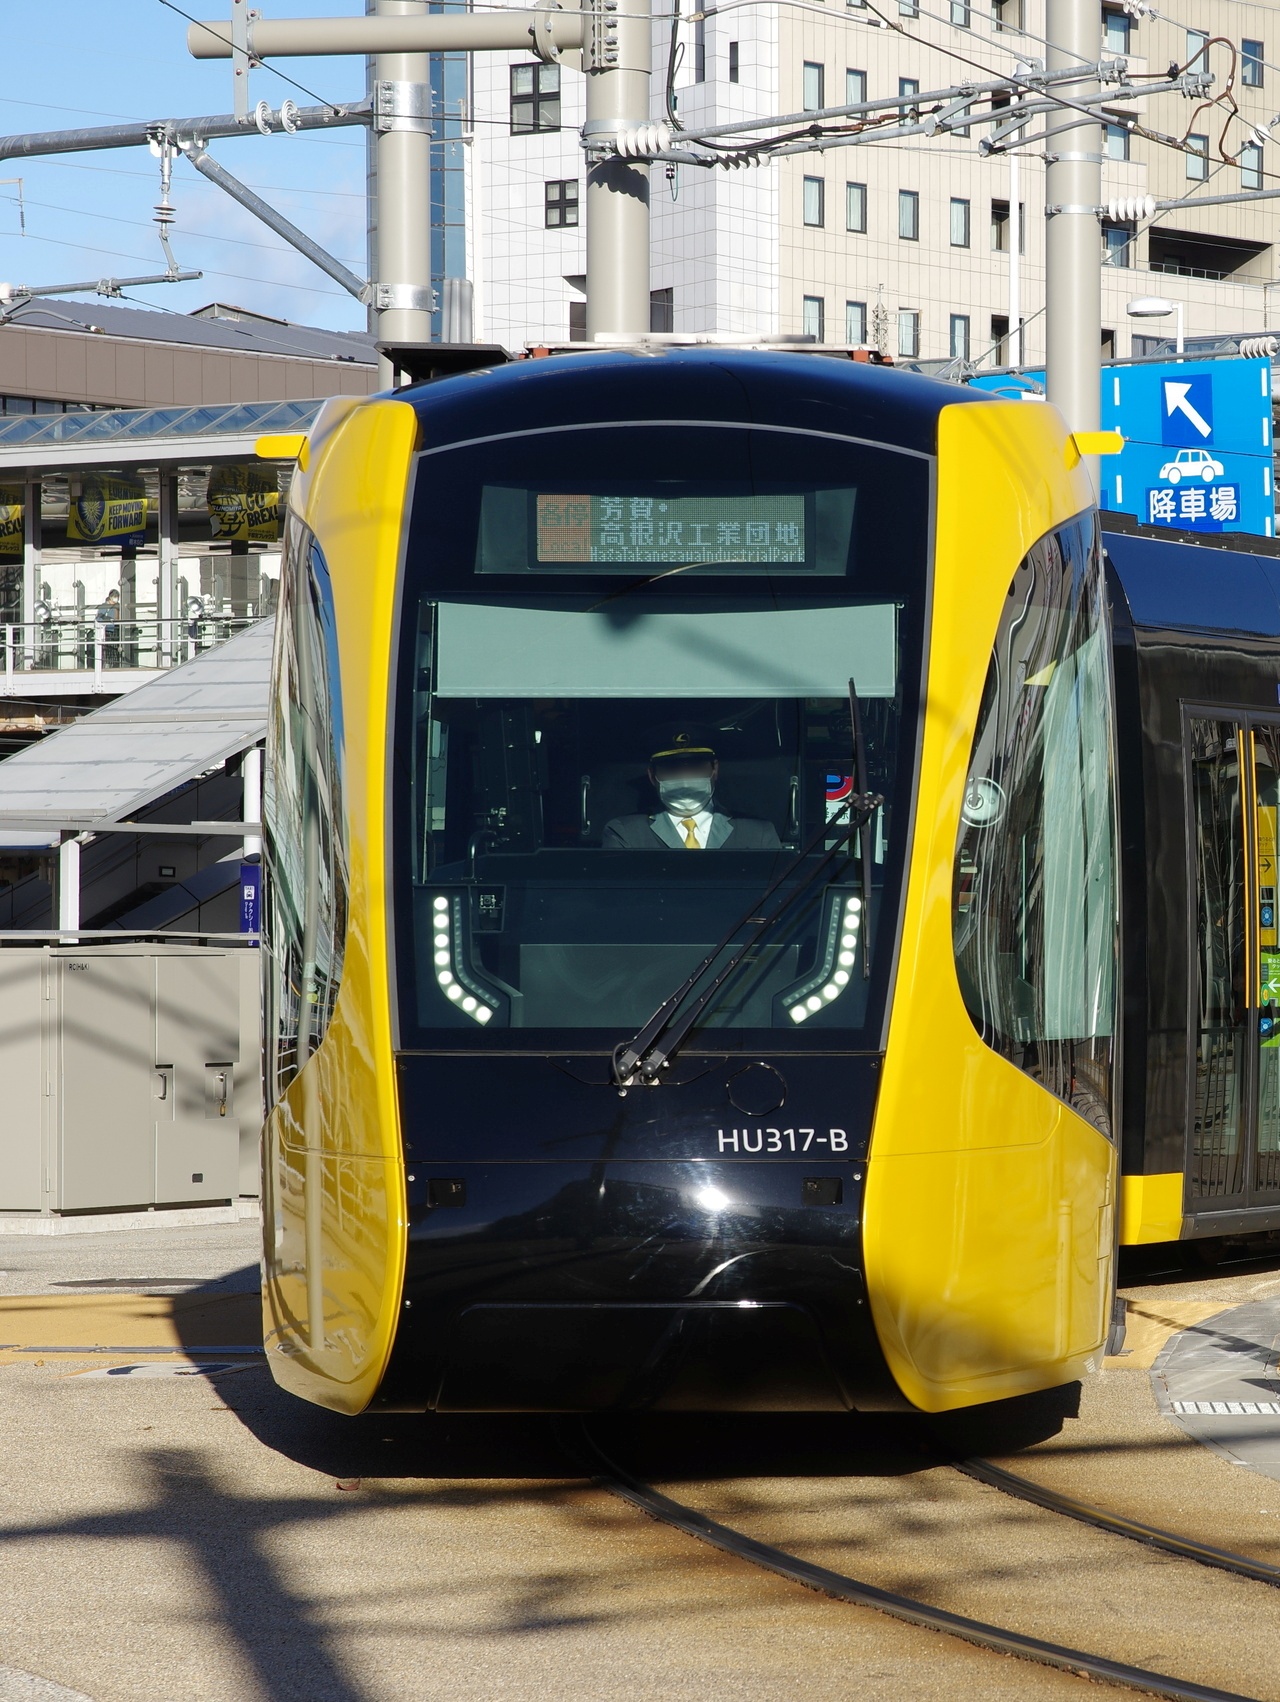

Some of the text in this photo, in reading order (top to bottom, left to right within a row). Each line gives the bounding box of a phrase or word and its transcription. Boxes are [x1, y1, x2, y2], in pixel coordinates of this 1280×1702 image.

[108, 500, 144, 516] KEEP MOVING
[246, 505, 278, 527] BREX!
[1149, 487, 1237, 523] 降車場
[0, 517, 22, 536] REX!
[108, 511, 143, 530] FORWARD
[601, 522, 798, 546] 高根沢工業団地
[718, 1128, 849, 1152] HU317-B
